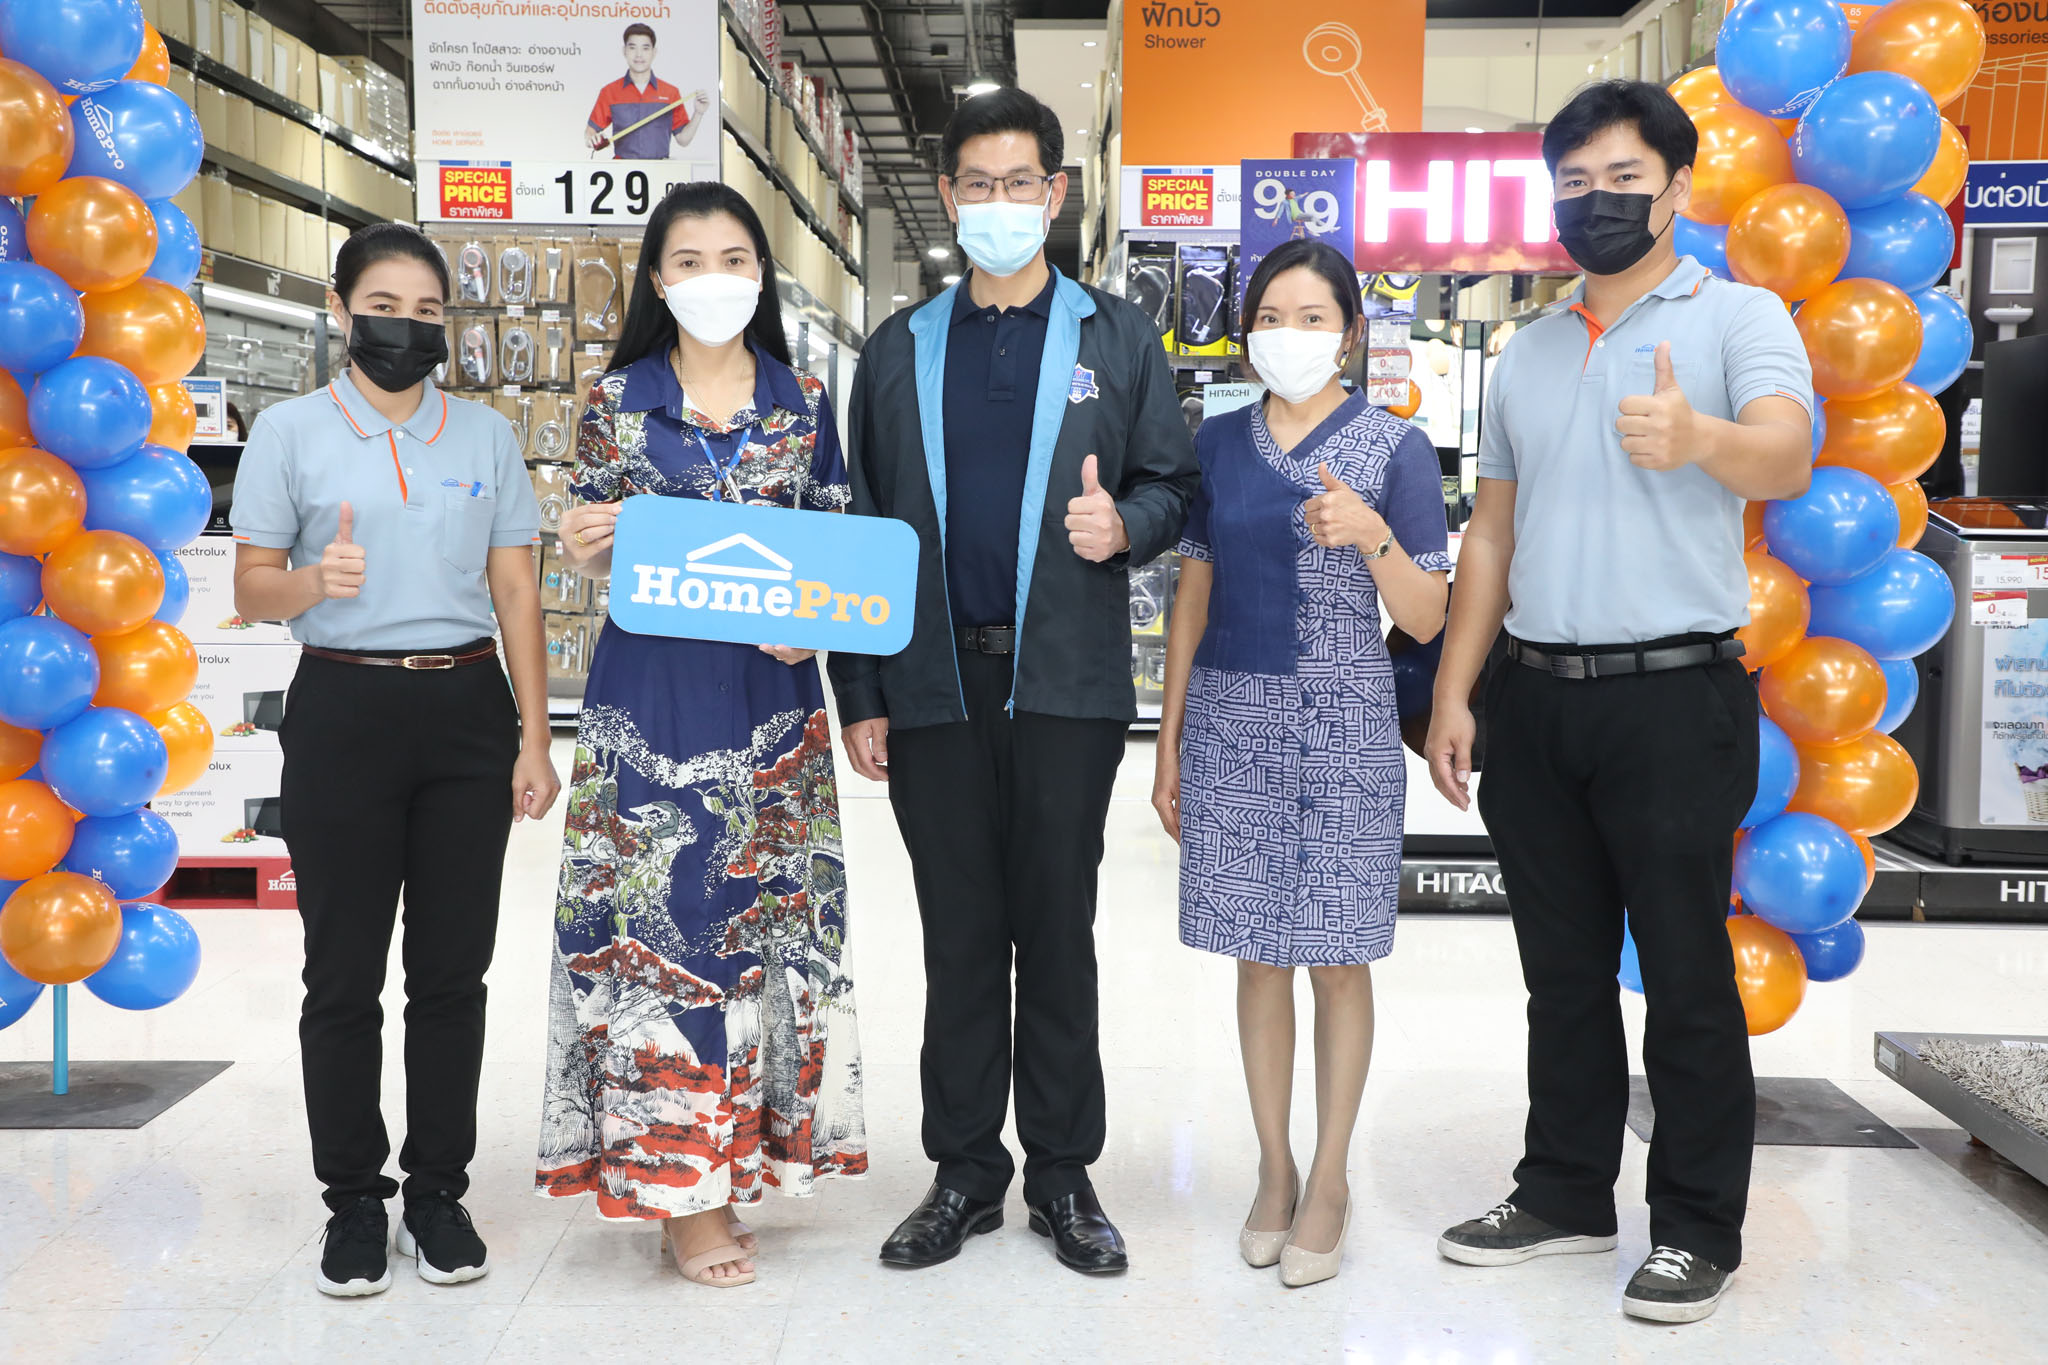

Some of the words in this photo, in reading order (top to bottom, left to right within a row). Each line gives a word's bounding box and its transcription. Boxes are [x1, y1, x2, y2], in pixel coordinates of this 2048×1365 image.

[1141, 0, 1221, 28] ฝักบัว
[1144, 33, 1207, 49] Shower
[80, 96, 125, 170] HomePro
[444, 170, 507, 185] SPECIAL
[1255, 169, 1308, 178] DOUBLE
[1311, 169, 1337, 178] DAY
[515, 181, 546, 196] ตั้งแต่
[555, 170, 649, 215] 129
[1147, 178, 1209, 192] SPECIAL
[443, 184, 508, 204] PRICE
[1146, 193, 1209, 211] PRICE
[448, 205, 505, 219] ราคาพิเศษ
[1150, 213, 1205, 226] ราคาพิเศษ
[1208, 387, 1251, 399] HITACHI
[630, 563, 891, 626] HomePro
[208, 761, 232, 771] olux
[174, 789, 212, 797] onvenient
[184, 800, 200, 808] give
